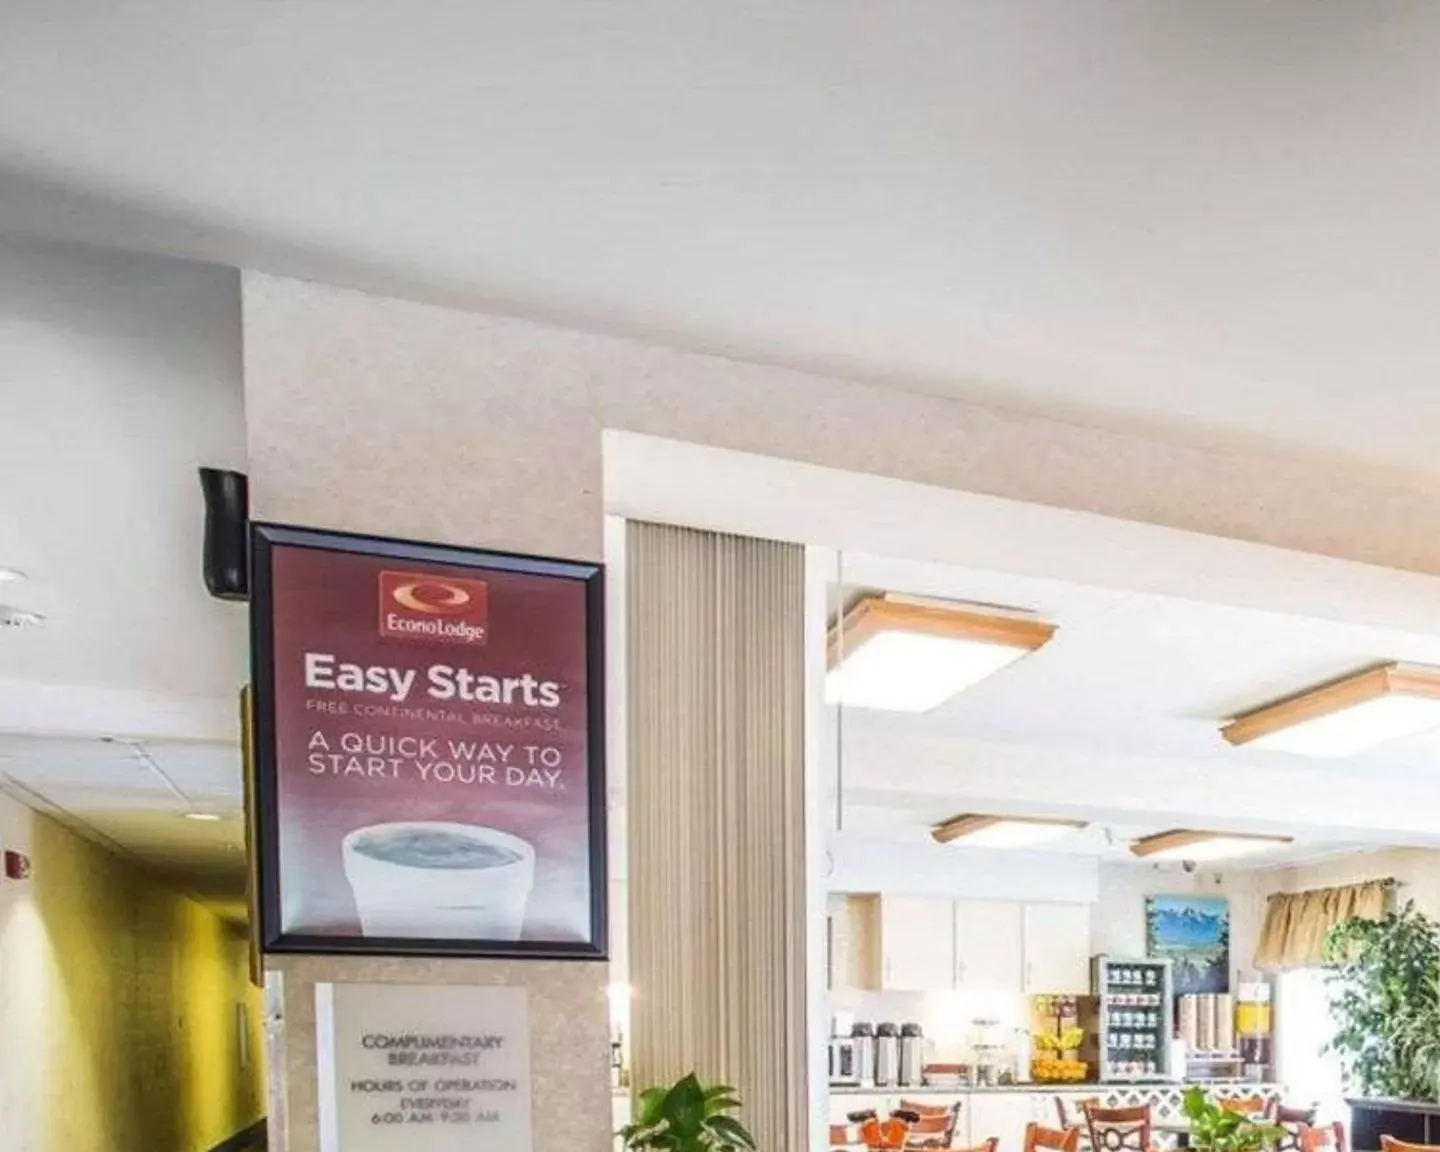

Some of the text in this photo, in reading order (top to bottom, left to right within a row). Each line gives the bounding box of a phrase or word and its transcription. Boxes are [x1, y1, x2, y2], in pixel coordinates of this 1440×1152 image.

[304, 651, 561, 708] Easy Starts
[305, 698, 348, 715] FREE
[353, 702, 467, 726] CONTINENTAL
[308, 730, 562, 768] A QUICK WAY TO
[308, 752, 567, 791] START YOUR DAY.
[388, 1052, 479, 1066] BREAKFAST
[351, 1078, 517, 1092] HOURS OF OPERATION
